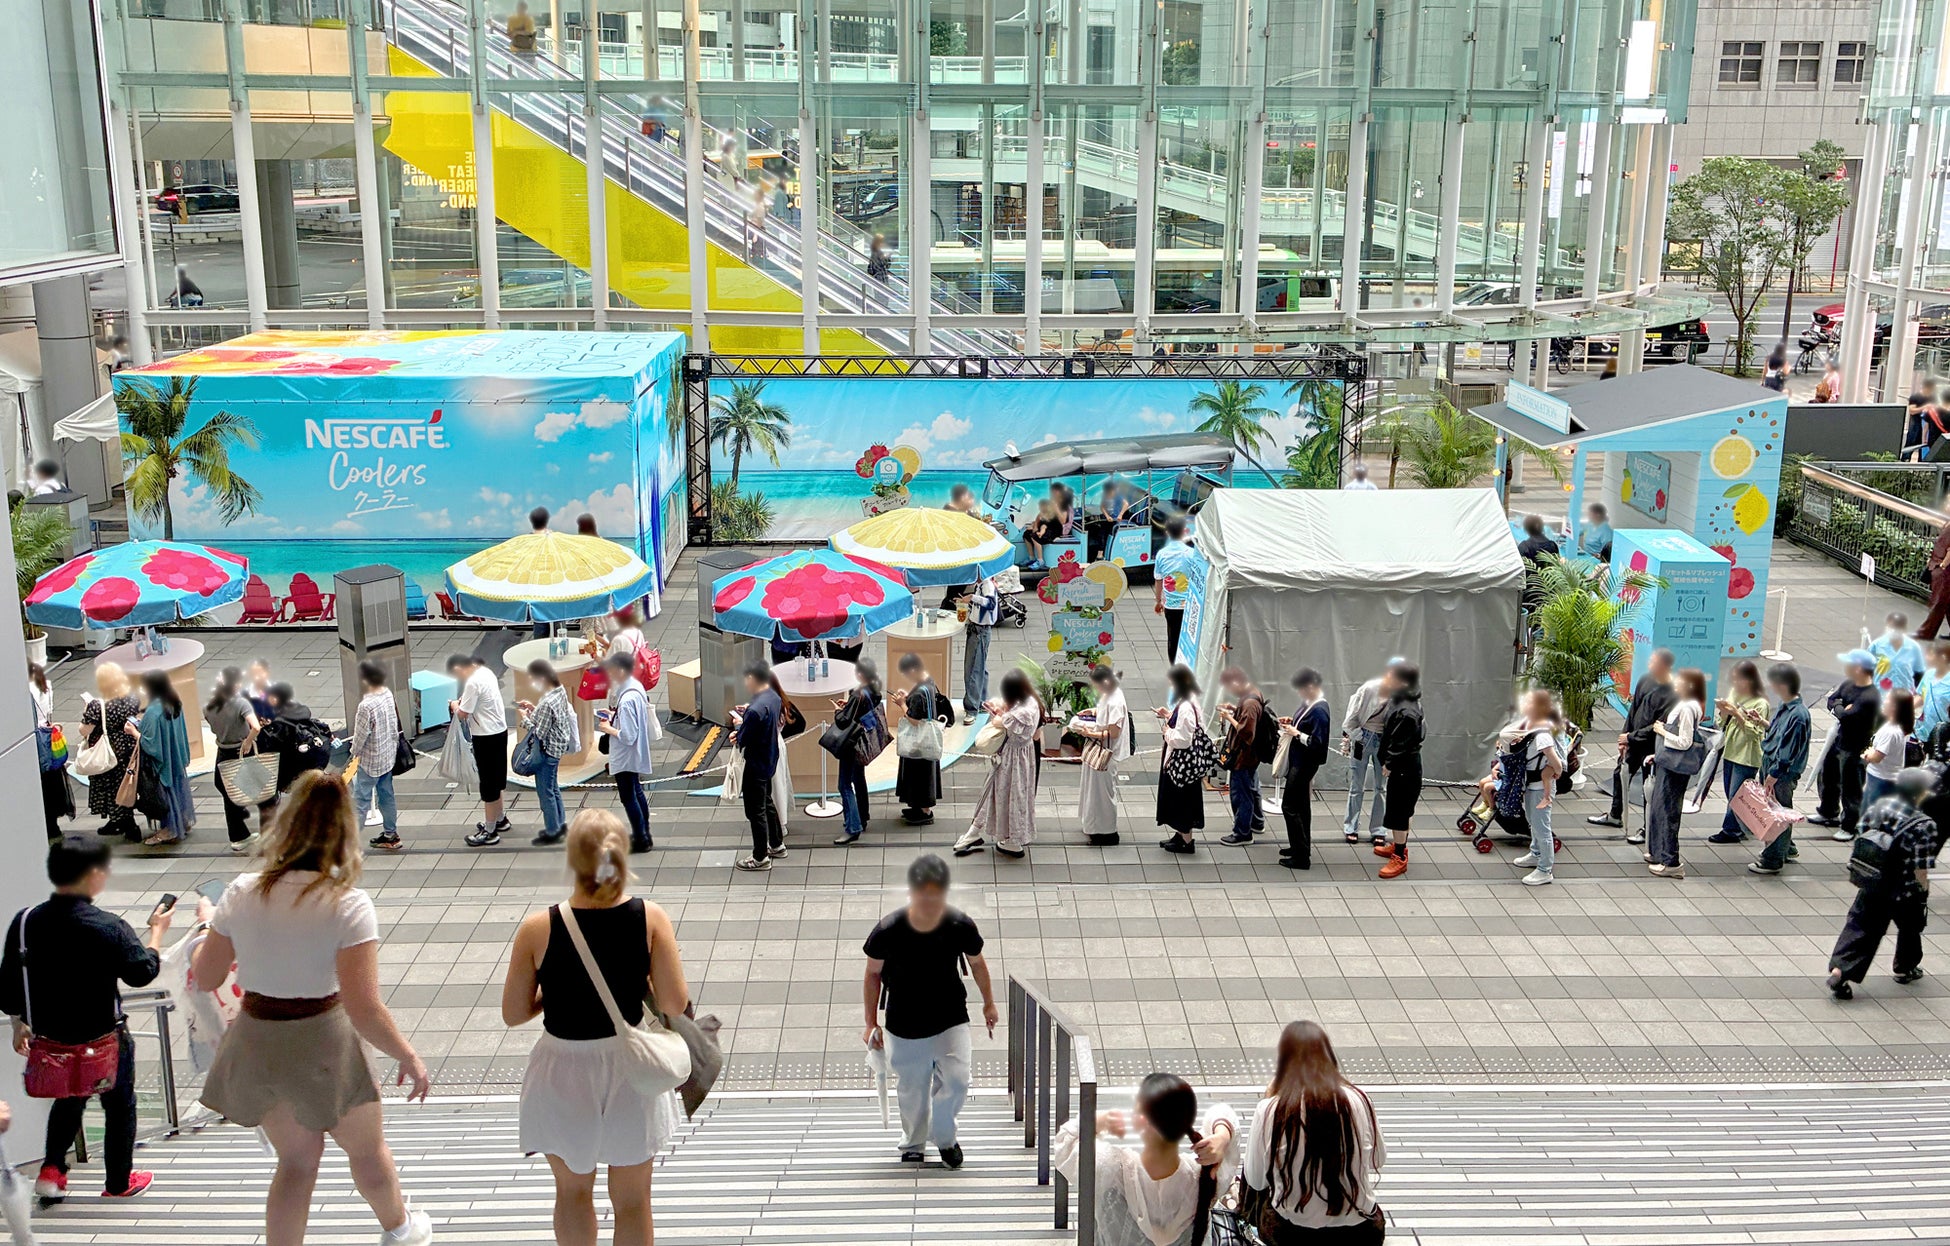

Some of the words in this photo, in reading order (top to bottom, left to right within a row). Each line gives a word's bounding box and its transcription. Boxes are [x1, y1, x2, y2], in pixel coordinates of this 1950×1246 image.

[304, 409, 445, 449] NESCAFÉ
[329, 450, 427, 491] Coolers
[354, 489, 409, 512] クーラー
